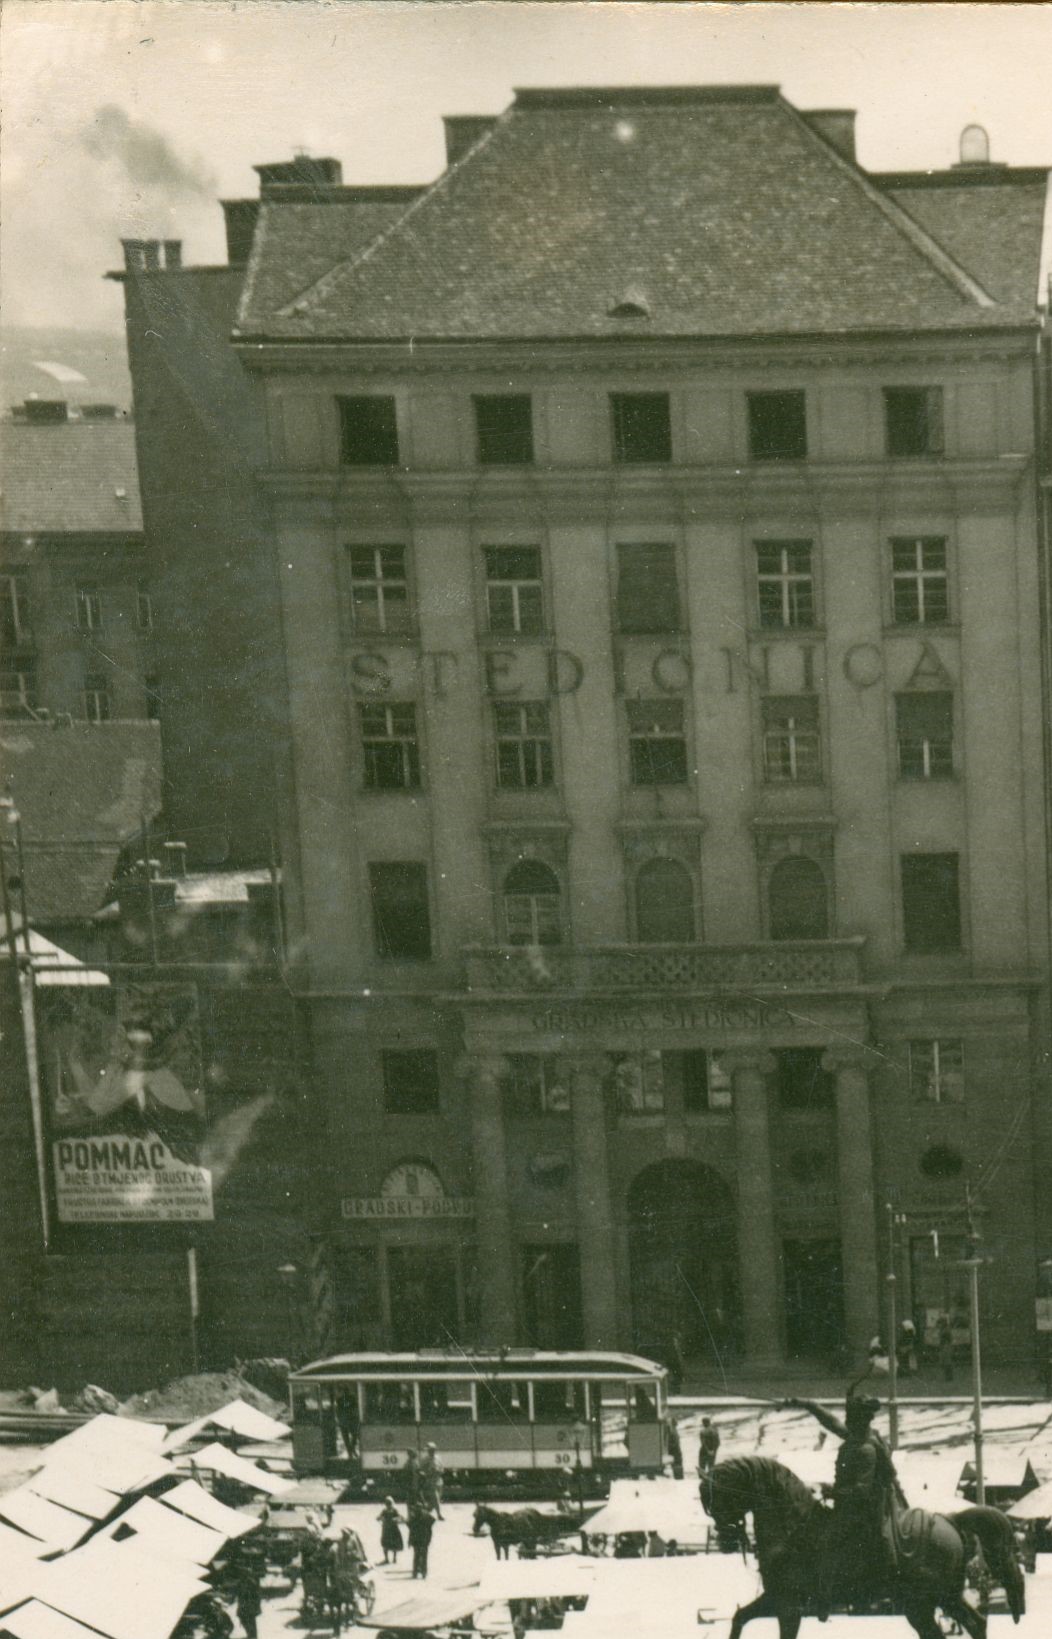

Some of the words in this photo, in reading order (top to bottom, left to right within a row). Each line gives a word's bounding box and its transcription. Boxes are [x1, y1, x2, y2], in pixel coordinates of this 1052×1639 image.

[58, 1141, 166, 1171] POMMAC
[382, 1454, 399, 1466] 30
[554, 1453, 571, 1465] 30
